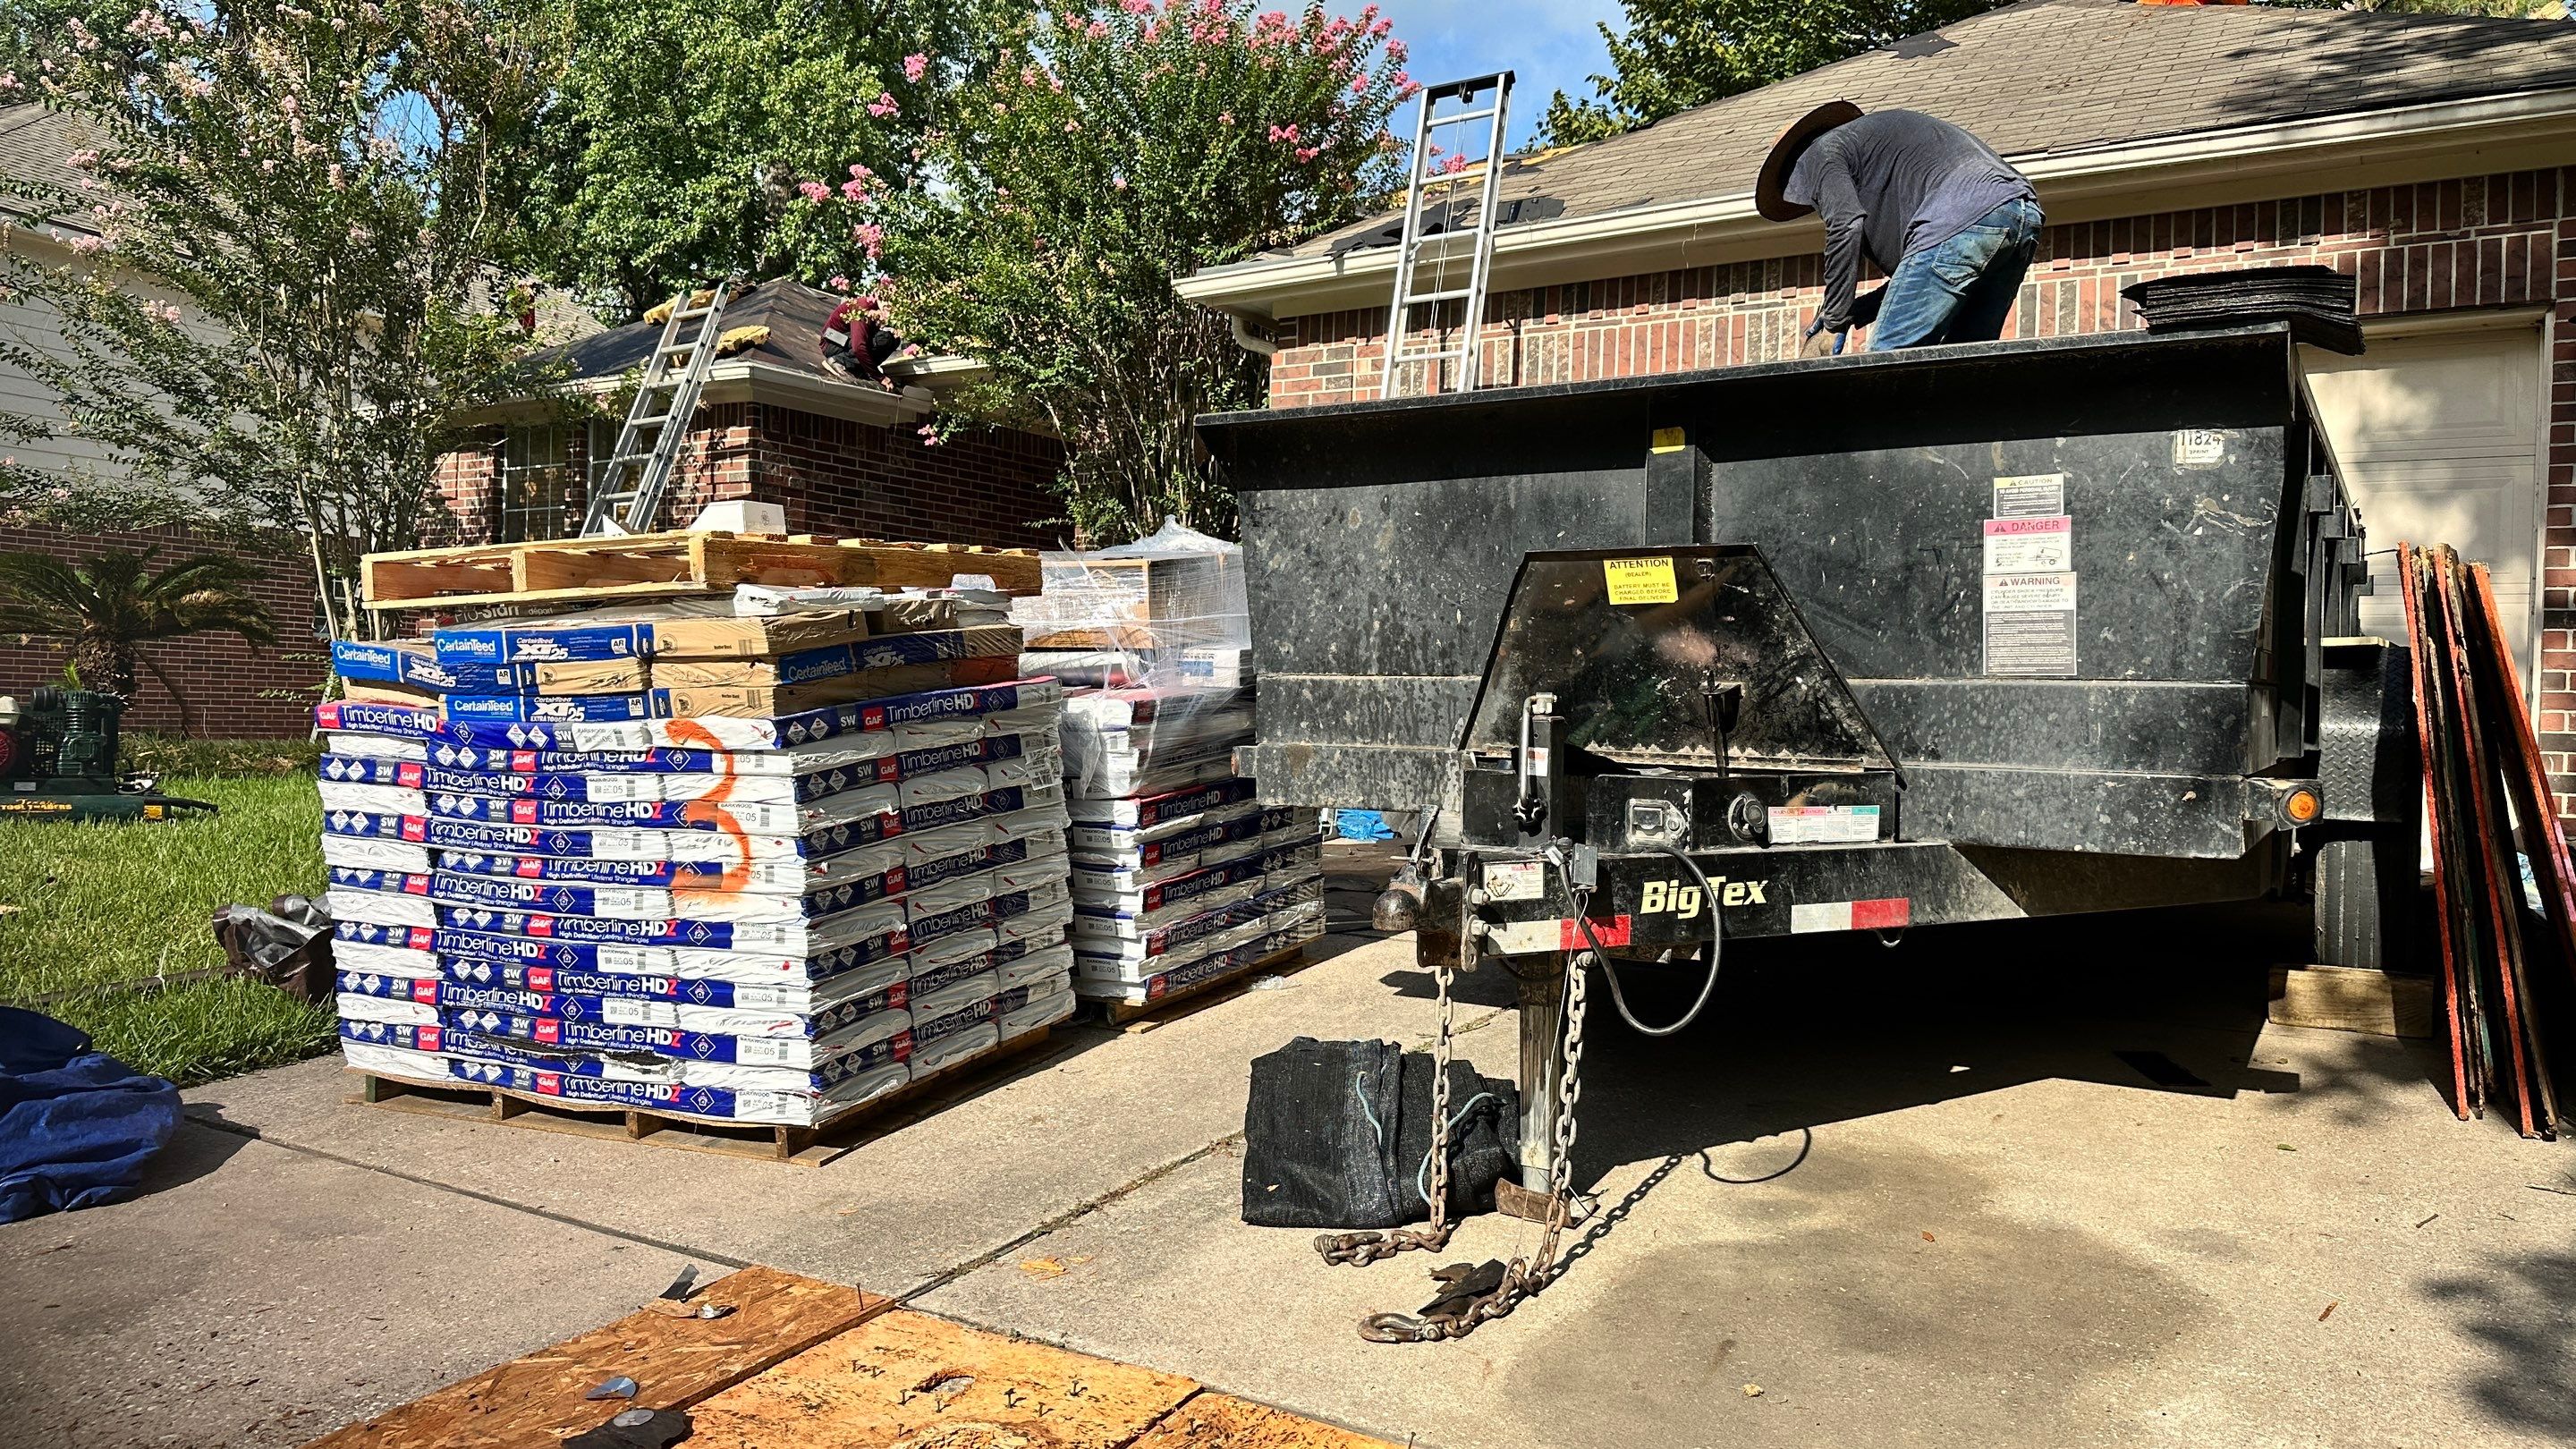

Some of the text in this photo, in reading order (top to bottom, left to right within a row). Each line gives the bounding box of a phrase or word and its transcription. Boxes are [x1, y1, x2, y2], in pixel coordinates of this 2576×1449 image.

[2012, 521, 2060, 531] DANGER
[1610, 559, 1669, 570] ATTENTION
[2011, 577, 2060, 586] WARNING
[437, 639, 496, 652] CertainTeed
[337, 646, 390, 665] CertainTeed
[550, 648, 568, 660] 25
[788, 657, 846, 682] CertainTeed
[438, 675, 457, 687] 25
[455, 700, 513, 711] CertainTeed
[886, 699, 953, 722] Timberline
[342, 706, 412, 728] Timberline
[567, 707, 585, 722] 25
[866, 716, 882, 724] GAF
[841, 716, 856, 726] SW
[555, 731, 572, 741] SW
[490, 750, 506, 758] SW
[900, 748, 962, 769] Timberline
[377, 767, 393, 775] SW
[402, 771, 419, 781] GAF
[858, 766, 872, 776] SW
[881, 766, 895, 775] GAF
[427, 767, 499, 787] Timberline
[489, 801, 507, 809] SW
[515, 806, 534, 814] GAF
[544, 801, 624, 818] Timberline
[1159, 794, 1206, 818] Timberline
[904, 801, 965, 822] Timberline
[381, 818, 396, 826] SW
[860, 819, 875, 832] SW
[884, 818, 899, 828] GAF
[404, 824, 423, 832] GAF
[431, 820, 505, 840] Timberline
[1163, 832, 1208, 855] Timberline
[910, 855, 970, 879] Timberline
[410, 876, 427, 886] GAF
[865, 877, 878, 890] SW
[887, 873, 903, 885] GAF
[434, 874, 509, 898] Timberline
[1165, 876, 1211, 897] Timberline
[558, 919, 640, 935] Timberline
[912, 910, 970, 936] Timberline
[388, 928, 402, 936] SW
[412, 934, 429, 942] GAF
[436, 930, 513, 955] Timberline
[868, 939, 882, 950] SW
[504, 968, 521, 978] SW
[392, 979, 408, 990] SW
[556, 970, 640, 991] Timberline
[416, 987, 434, 996] GAF
[441, 981, 517, 1003] Timberline
[891, 992, 905, 1002] GAF
[868, 995, 883, 1009] SW
[513, 1018, 529, 1028] SW
[396, 1026, 411, 1036] SW
[539, 1025, 556, 1033] GAF
[564, 1021, 645, 1042] Timberline
[420, 1033, 436, 1042] GAF
[873, 1042, 887, 1055] SW
[539, 1078, 555, 1087] GAF
[564, 1076, 644, 1096] Timberline
